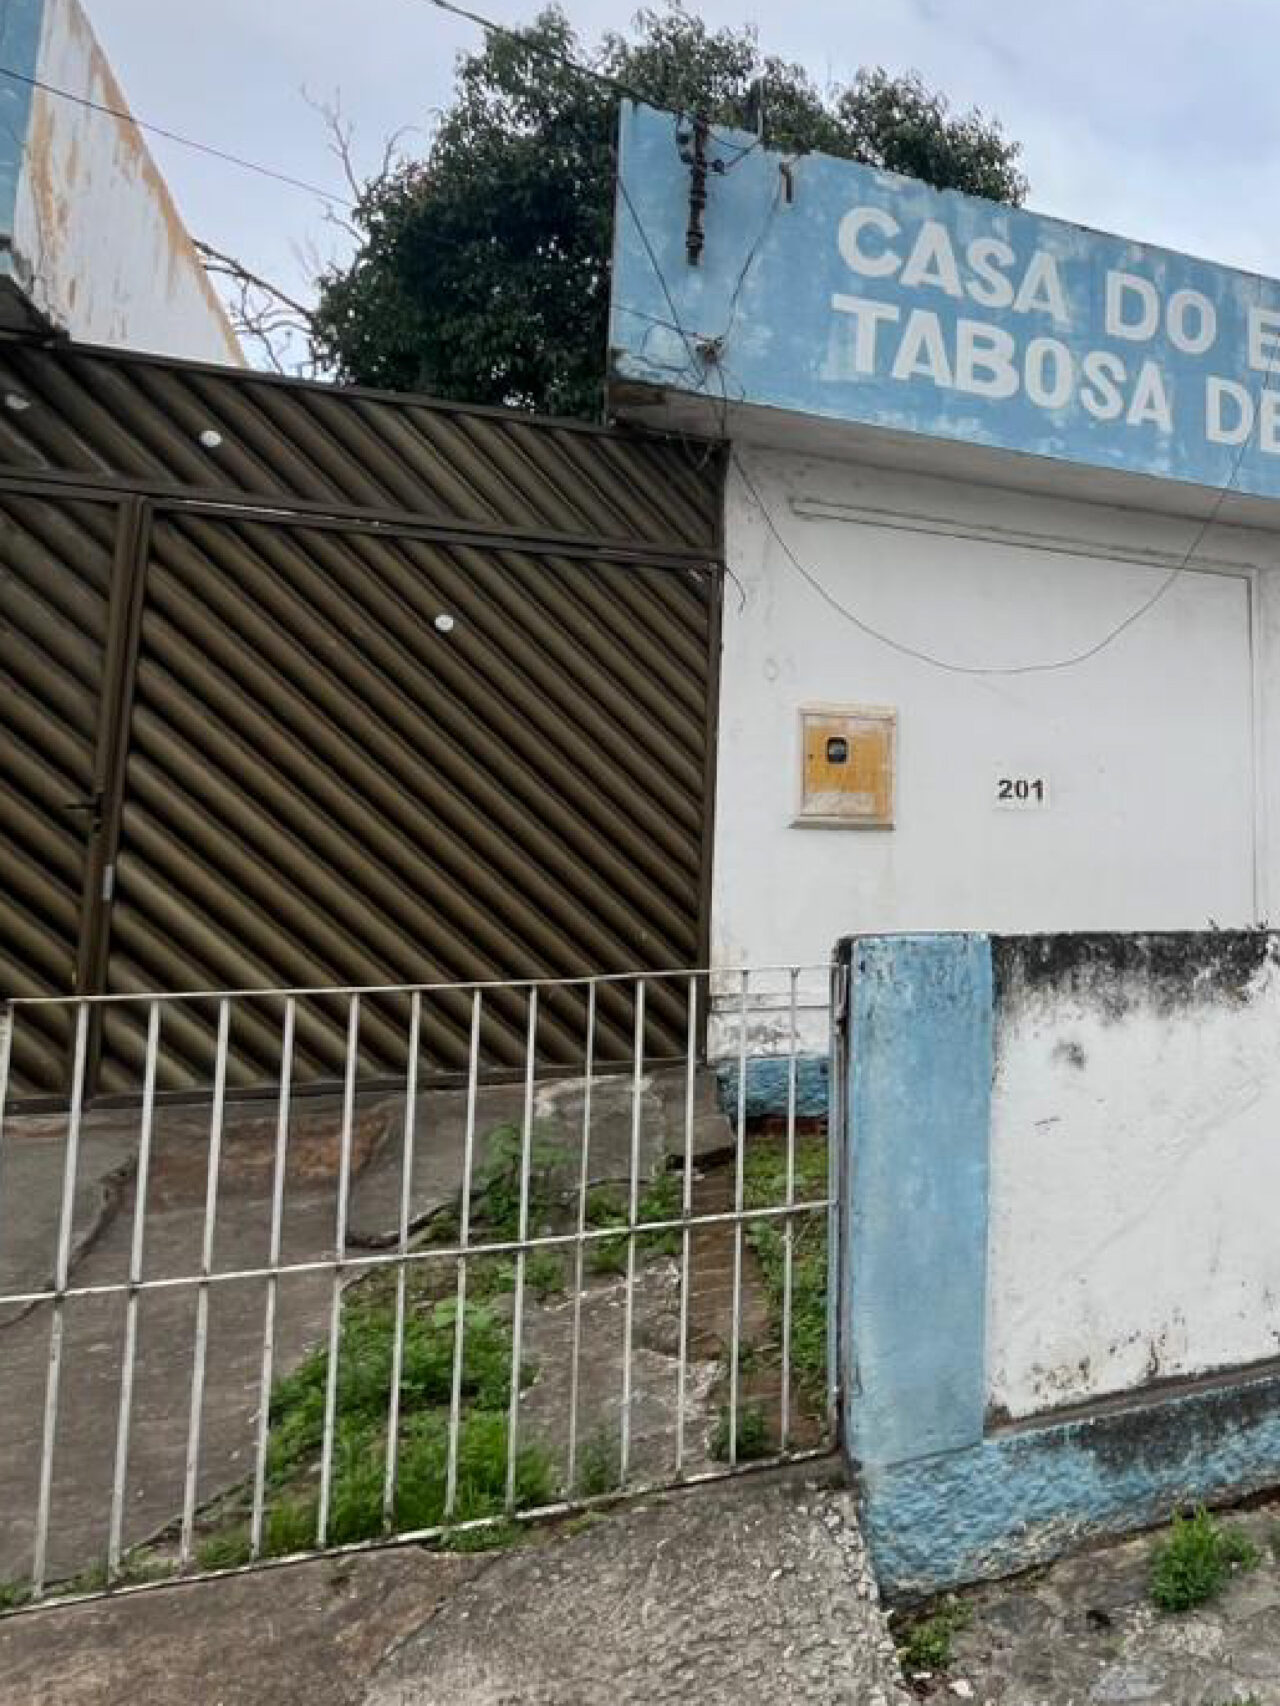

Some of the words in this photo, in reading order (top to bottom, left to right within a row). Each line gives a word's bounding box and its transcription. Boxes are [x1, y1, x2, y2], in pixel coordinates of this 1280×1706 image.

[838, 207, 1071, 331] CASA
[1105, 272, 1217, 355] DO
[833, 295, 1173, 432] TABOSA
[998, 779, 1043, 801] 201
